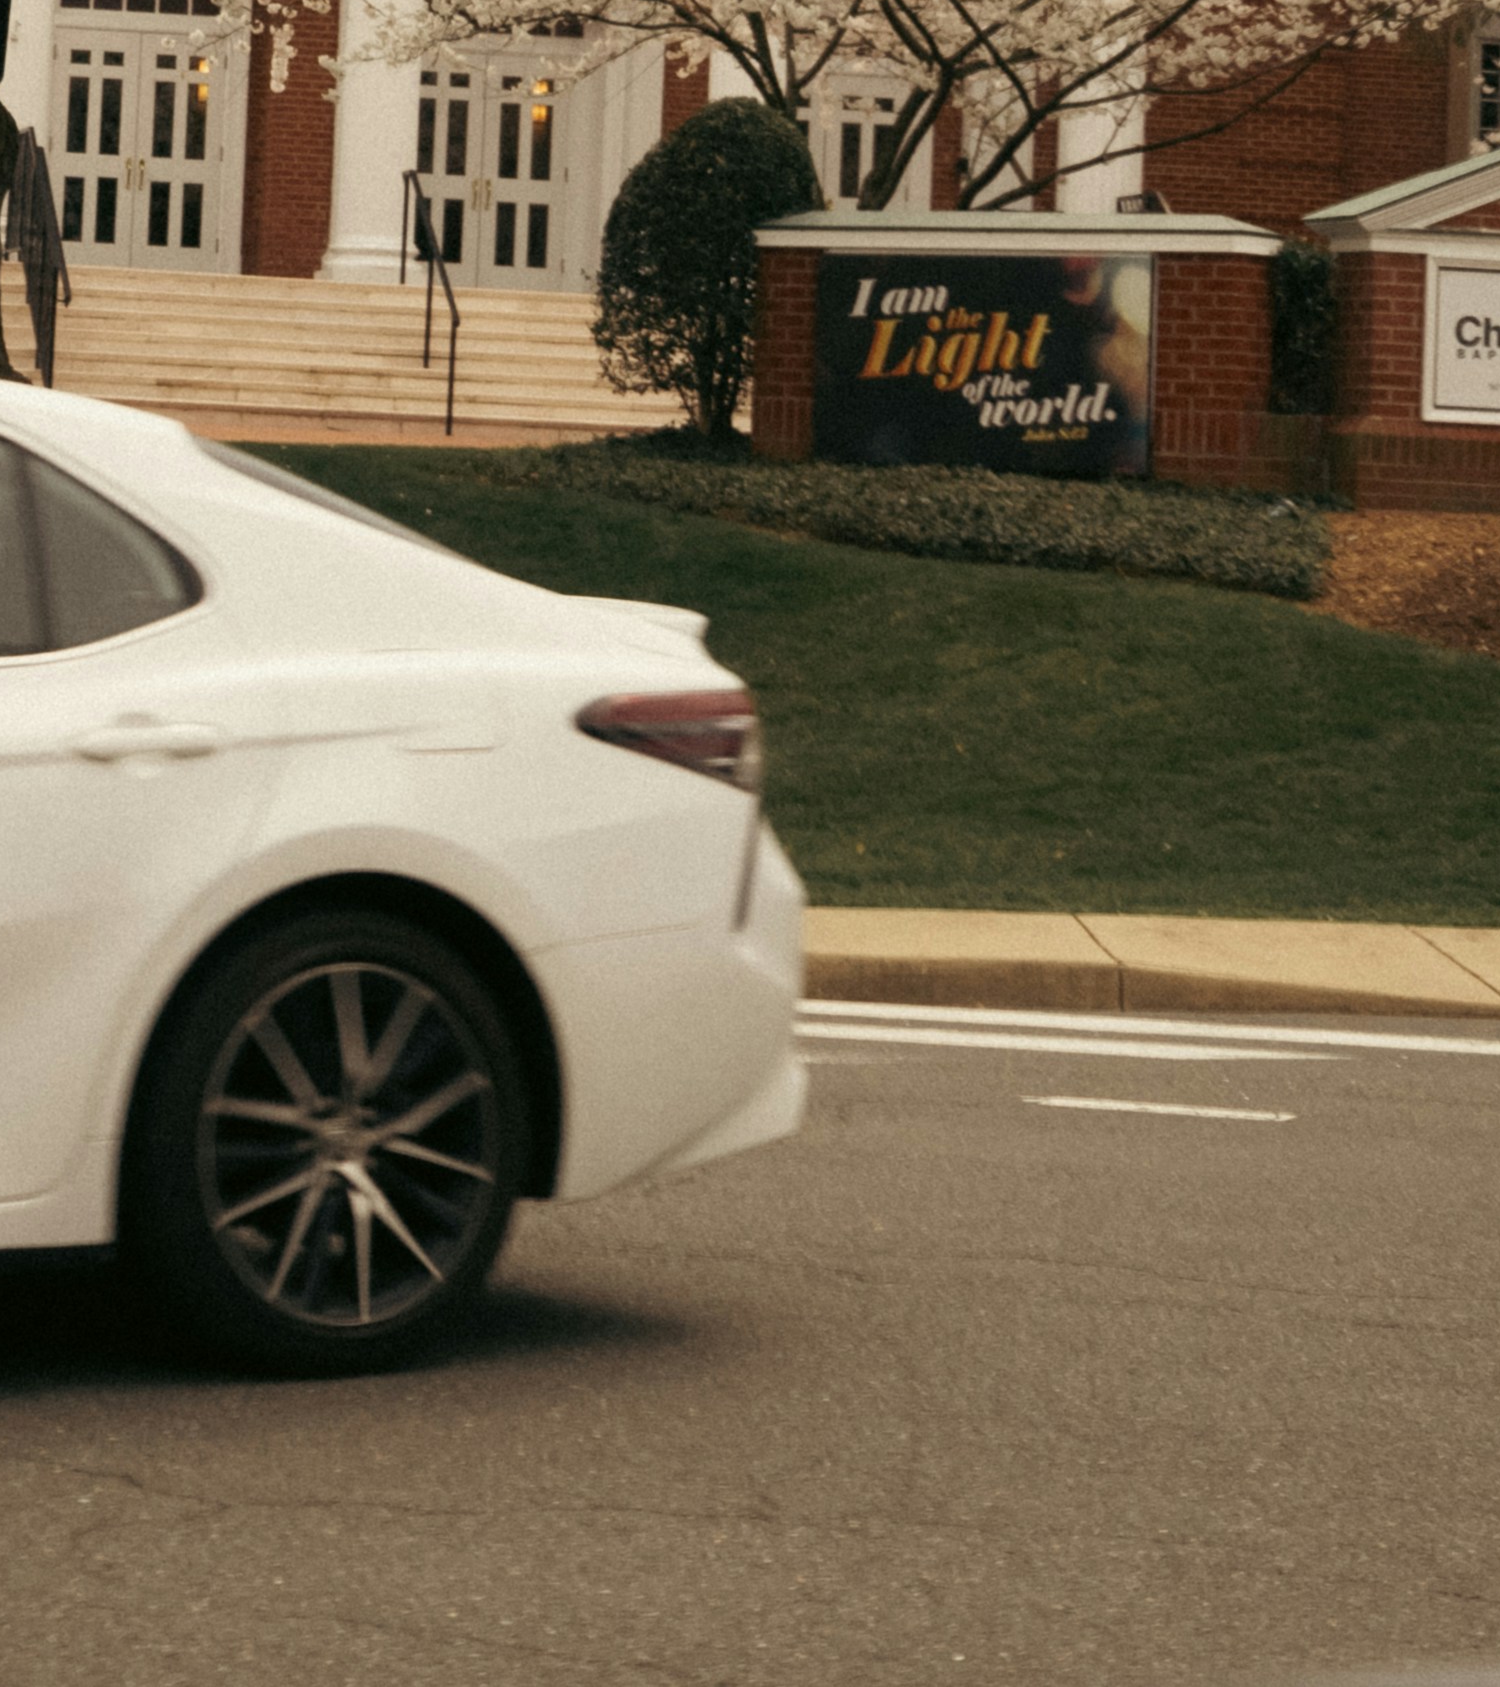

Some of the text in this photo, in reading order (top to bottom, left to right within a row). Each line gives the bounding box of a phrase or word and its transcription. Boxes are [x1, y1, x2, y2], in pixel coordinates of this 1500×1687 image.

[849, 278, 949, 317] I am
[945, 306, 984, 329] the
[857, 311, 1052, 391] Light
[961, 372, 1030, 405] of the
[978, 381, 1118, 428] world.
